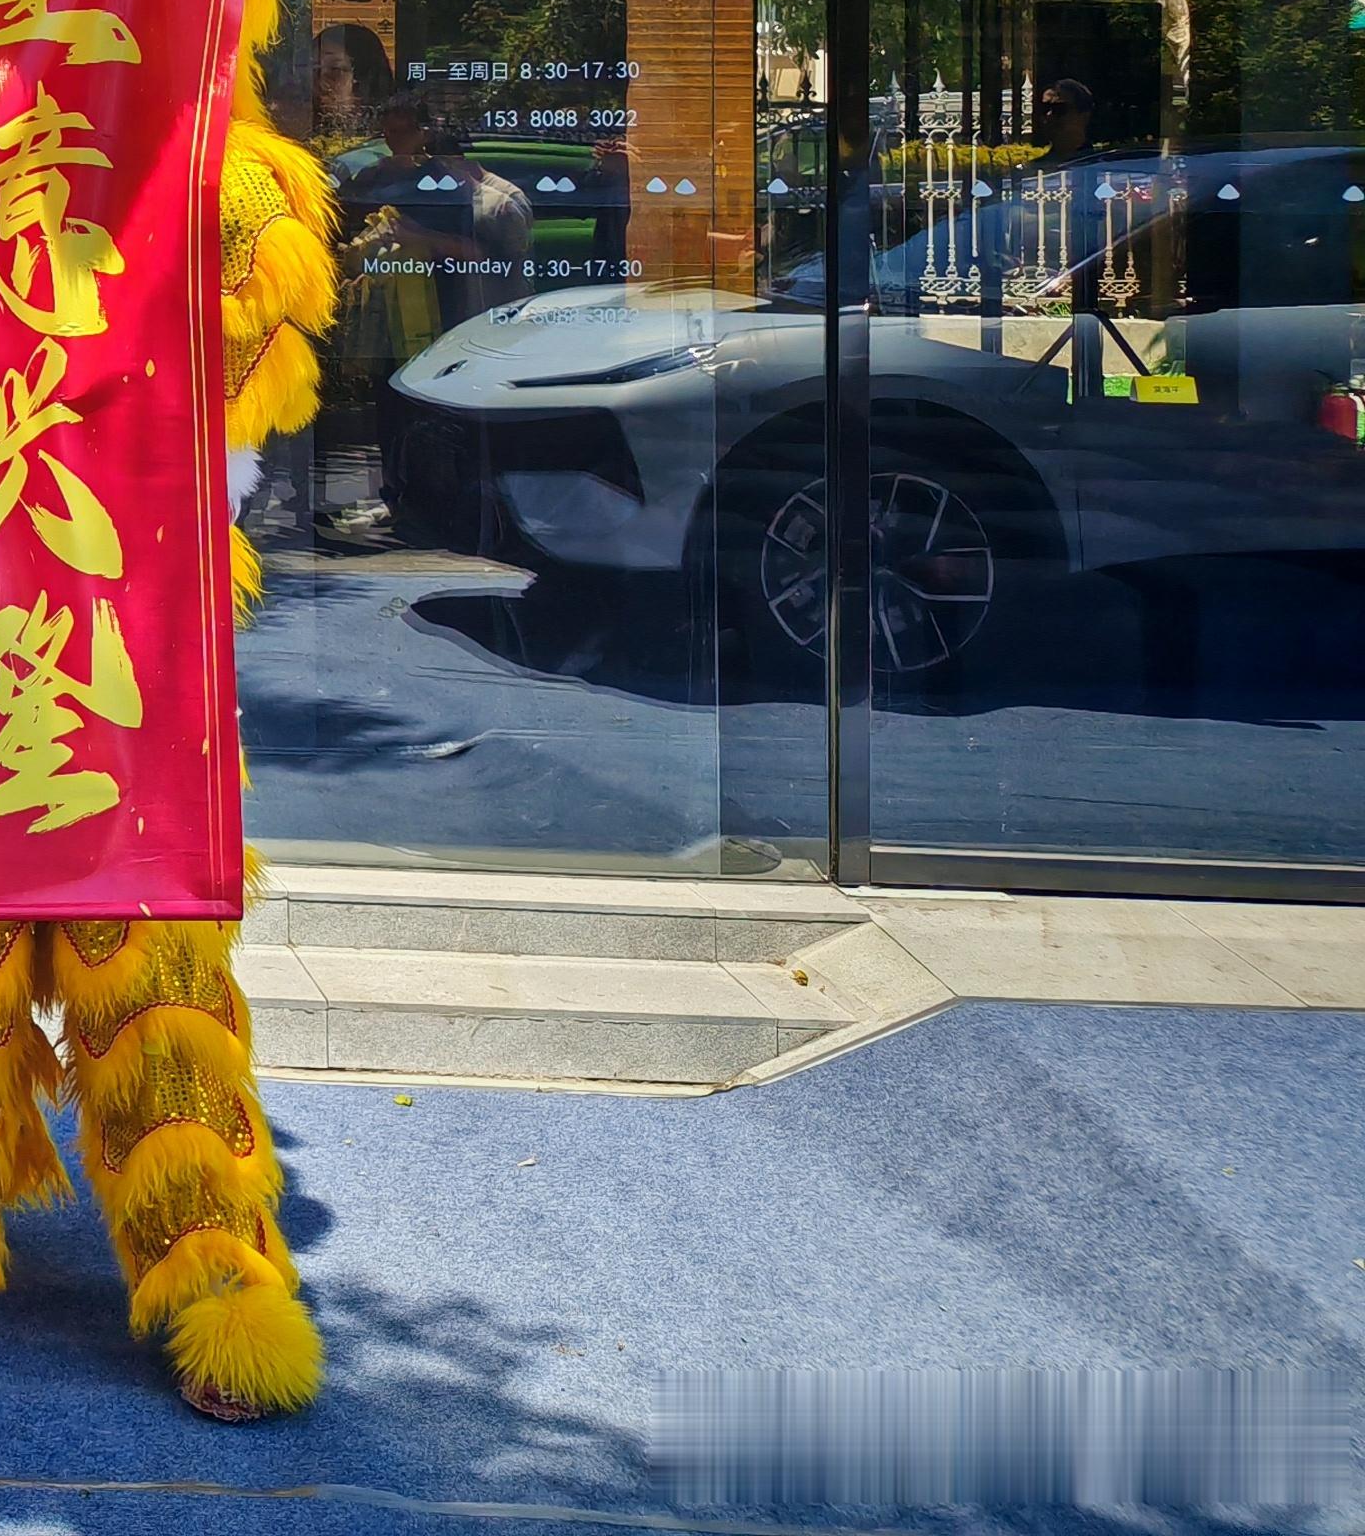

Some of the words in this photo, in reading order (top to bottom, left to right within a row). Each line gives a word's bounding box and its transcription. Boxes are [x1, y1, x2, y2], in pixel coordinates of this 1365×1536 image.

[407, 62, 508, 81] 周一至周日
[484, 110, 518, 127] 153
[530, 110, 578, 127] 8088
[589, 110, 638, 127] 3022
[363, 257, 512, 277] Monday-Sunday
